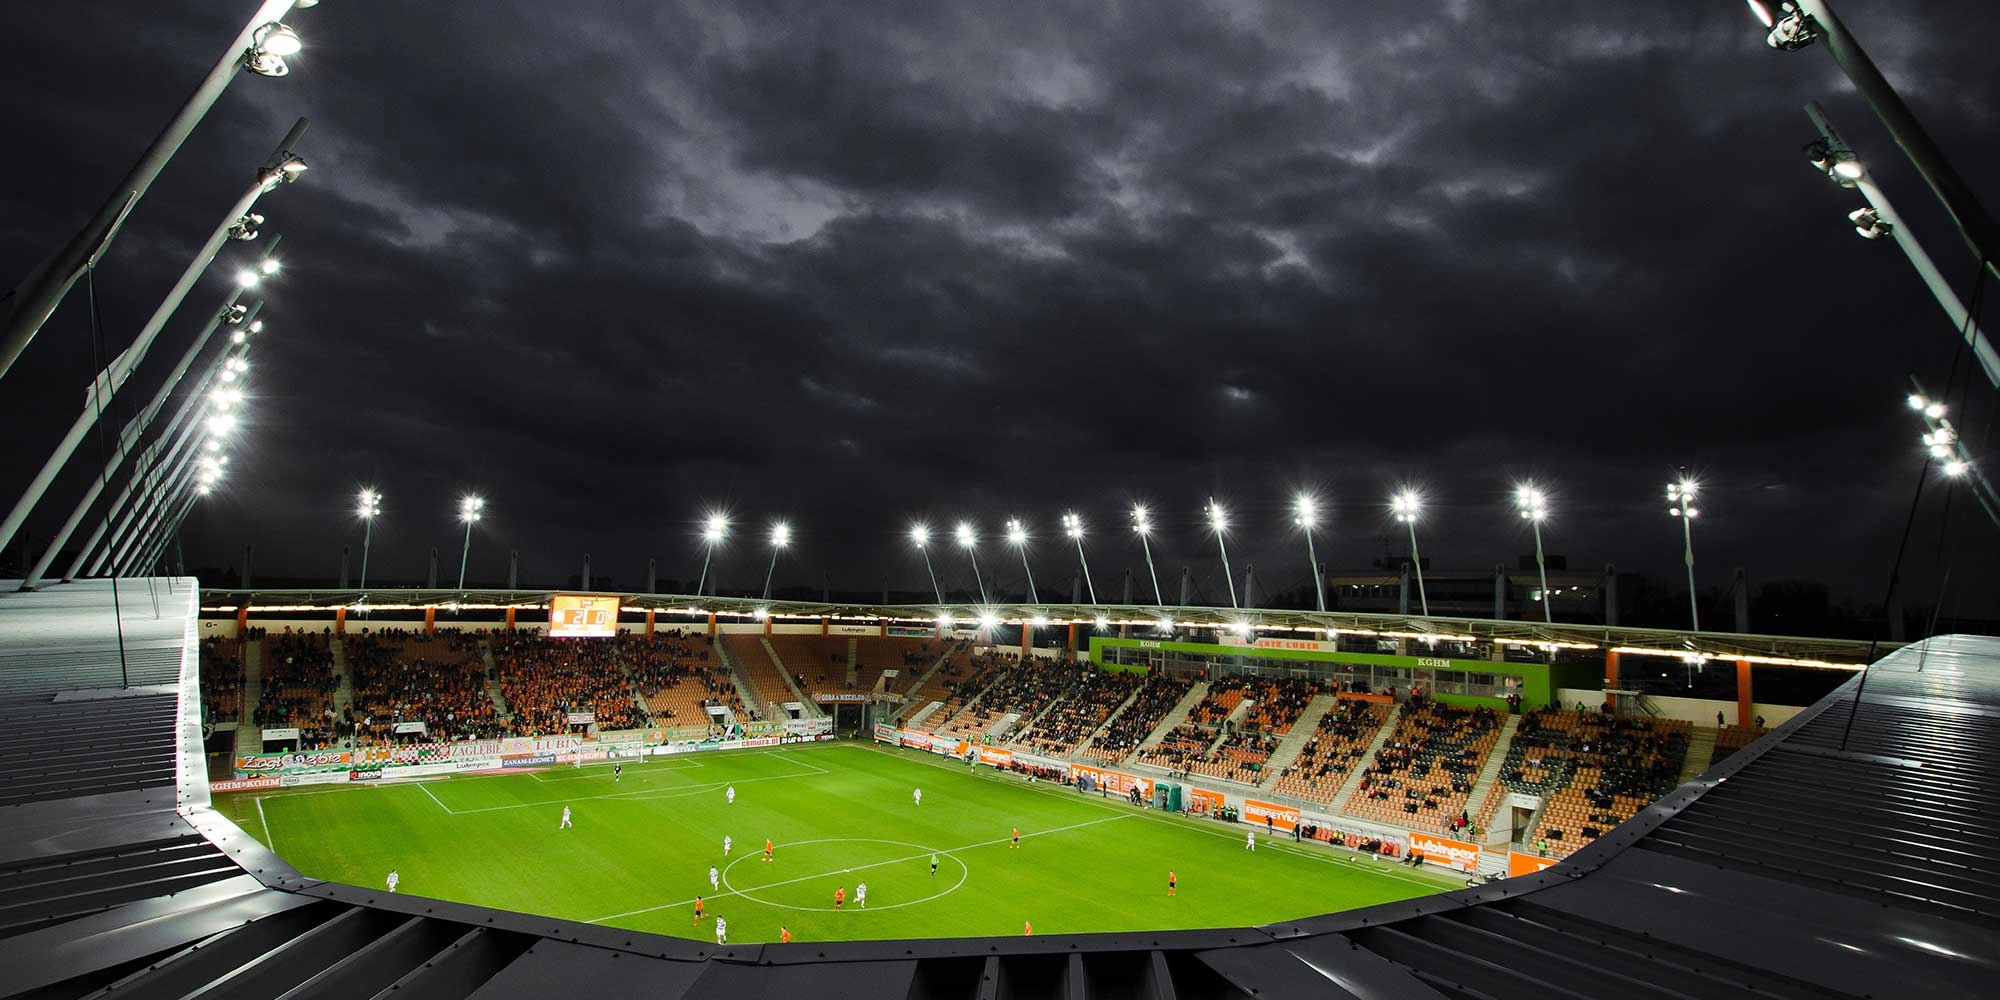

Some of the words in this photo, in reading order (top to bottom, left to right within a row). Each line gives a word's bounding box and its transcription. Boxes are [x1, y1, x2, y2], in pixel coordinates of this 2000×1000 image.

[573, 611, 584, 624] 2
[595, 611, 606, 624] 0
[1286, 641, 1318, 649] LUBIN
[1418, 658, 1451, 668] KGHM
[536, 739, 579, 751] LUBIN
[246, 778, 280, 788] KGHM
[1410, 836, 1476, 862] Lubinpex
